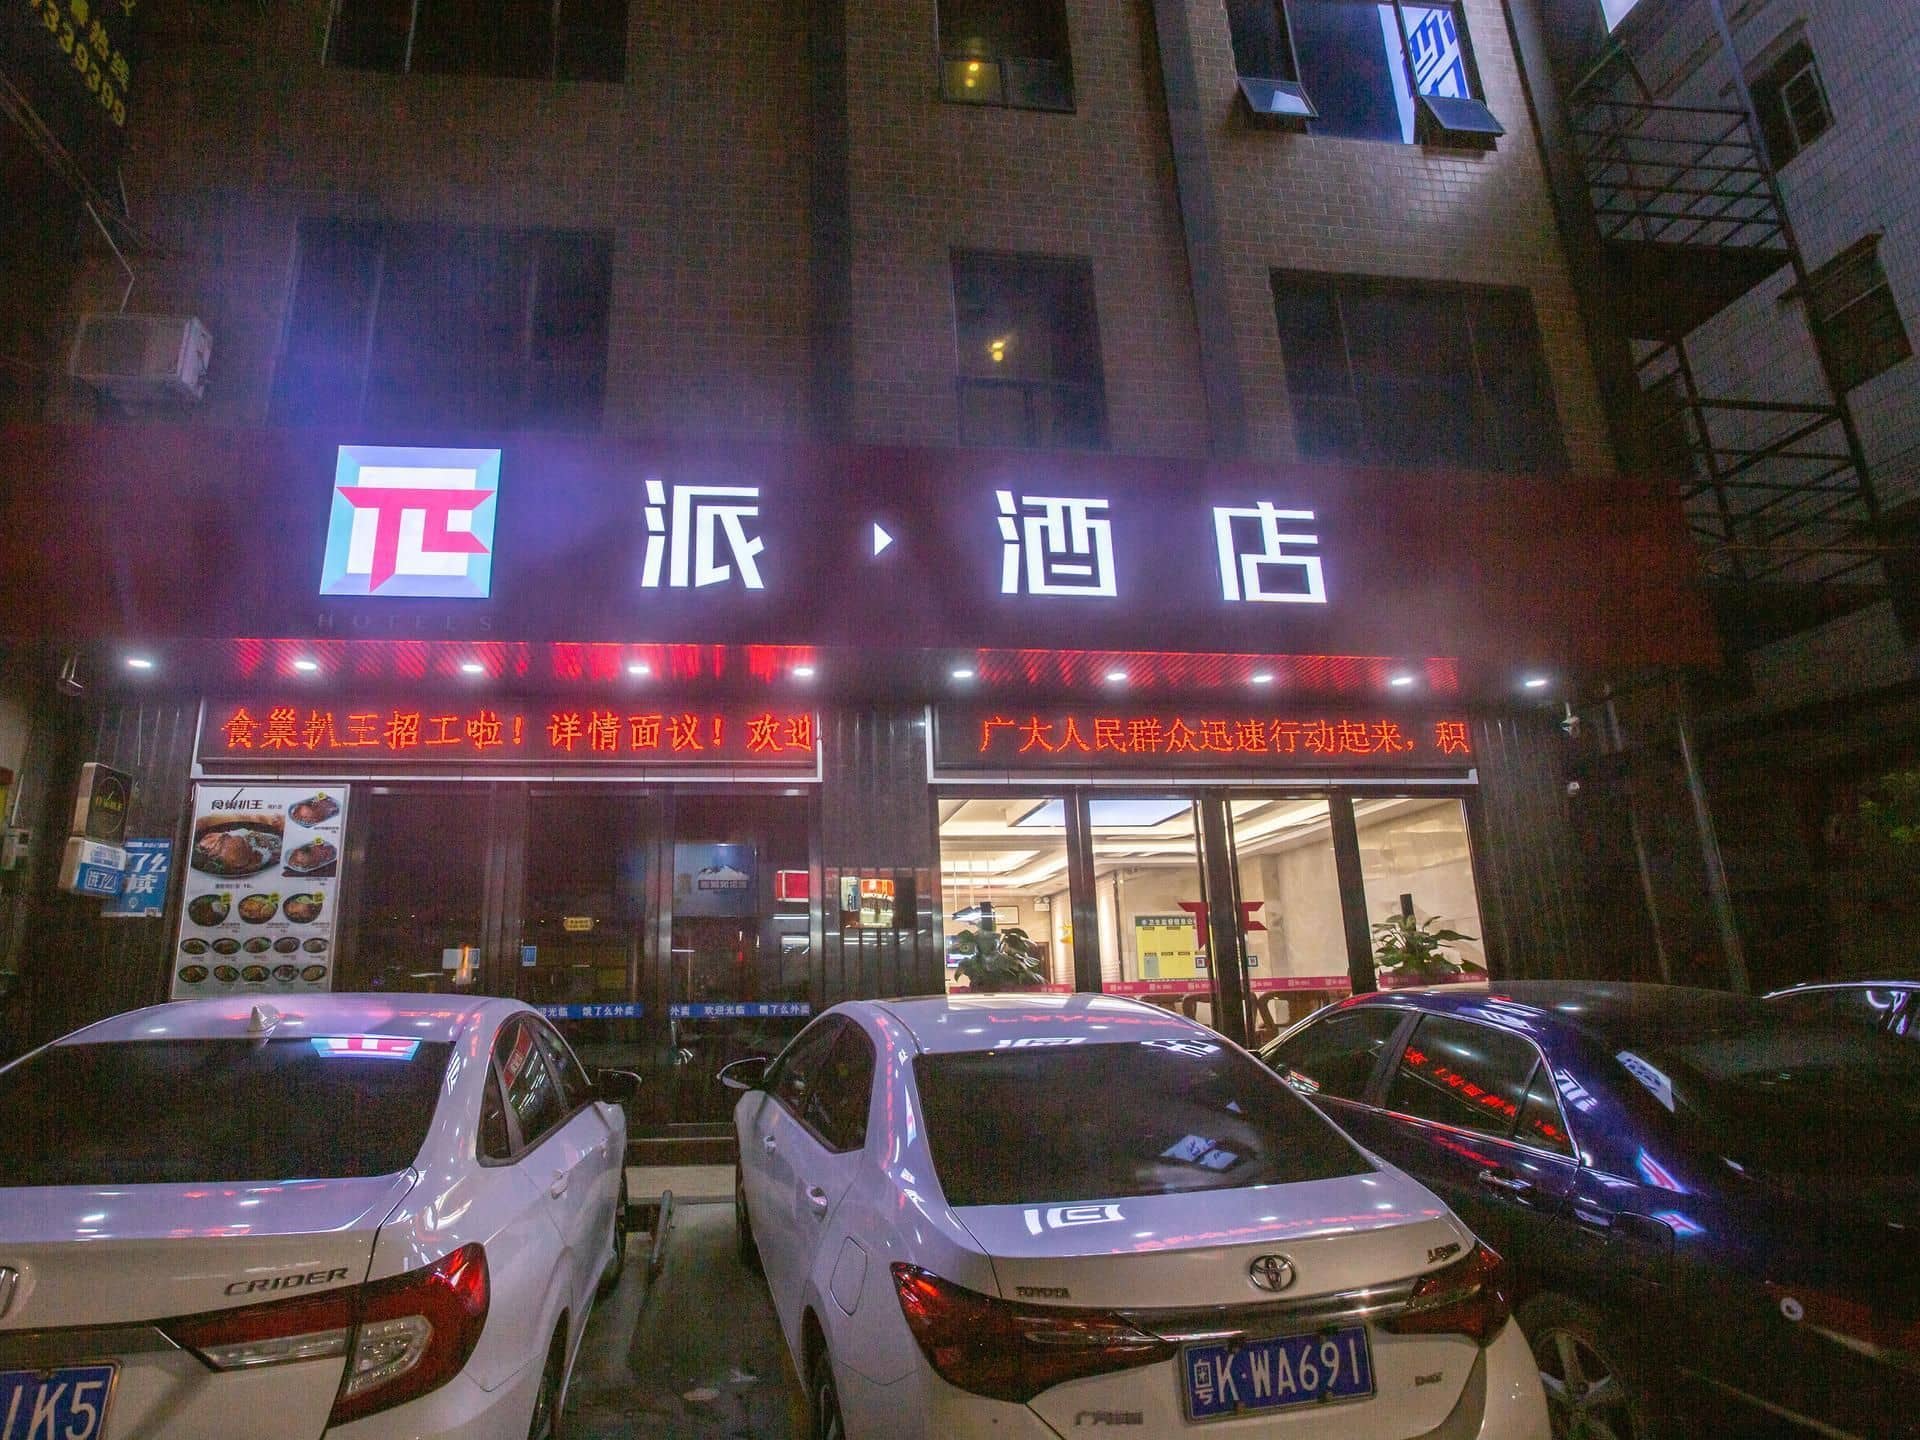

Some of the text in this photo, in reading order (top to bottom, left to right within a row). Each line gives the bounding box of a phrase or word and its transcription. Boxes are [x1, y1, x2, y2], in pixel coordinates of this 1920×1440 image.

[640, 479, 1328, 604] 派 酒店
[224, 1266, 350, 1298] CRIDER
[1015, 1286, 1072, 1299] TOYOTA
